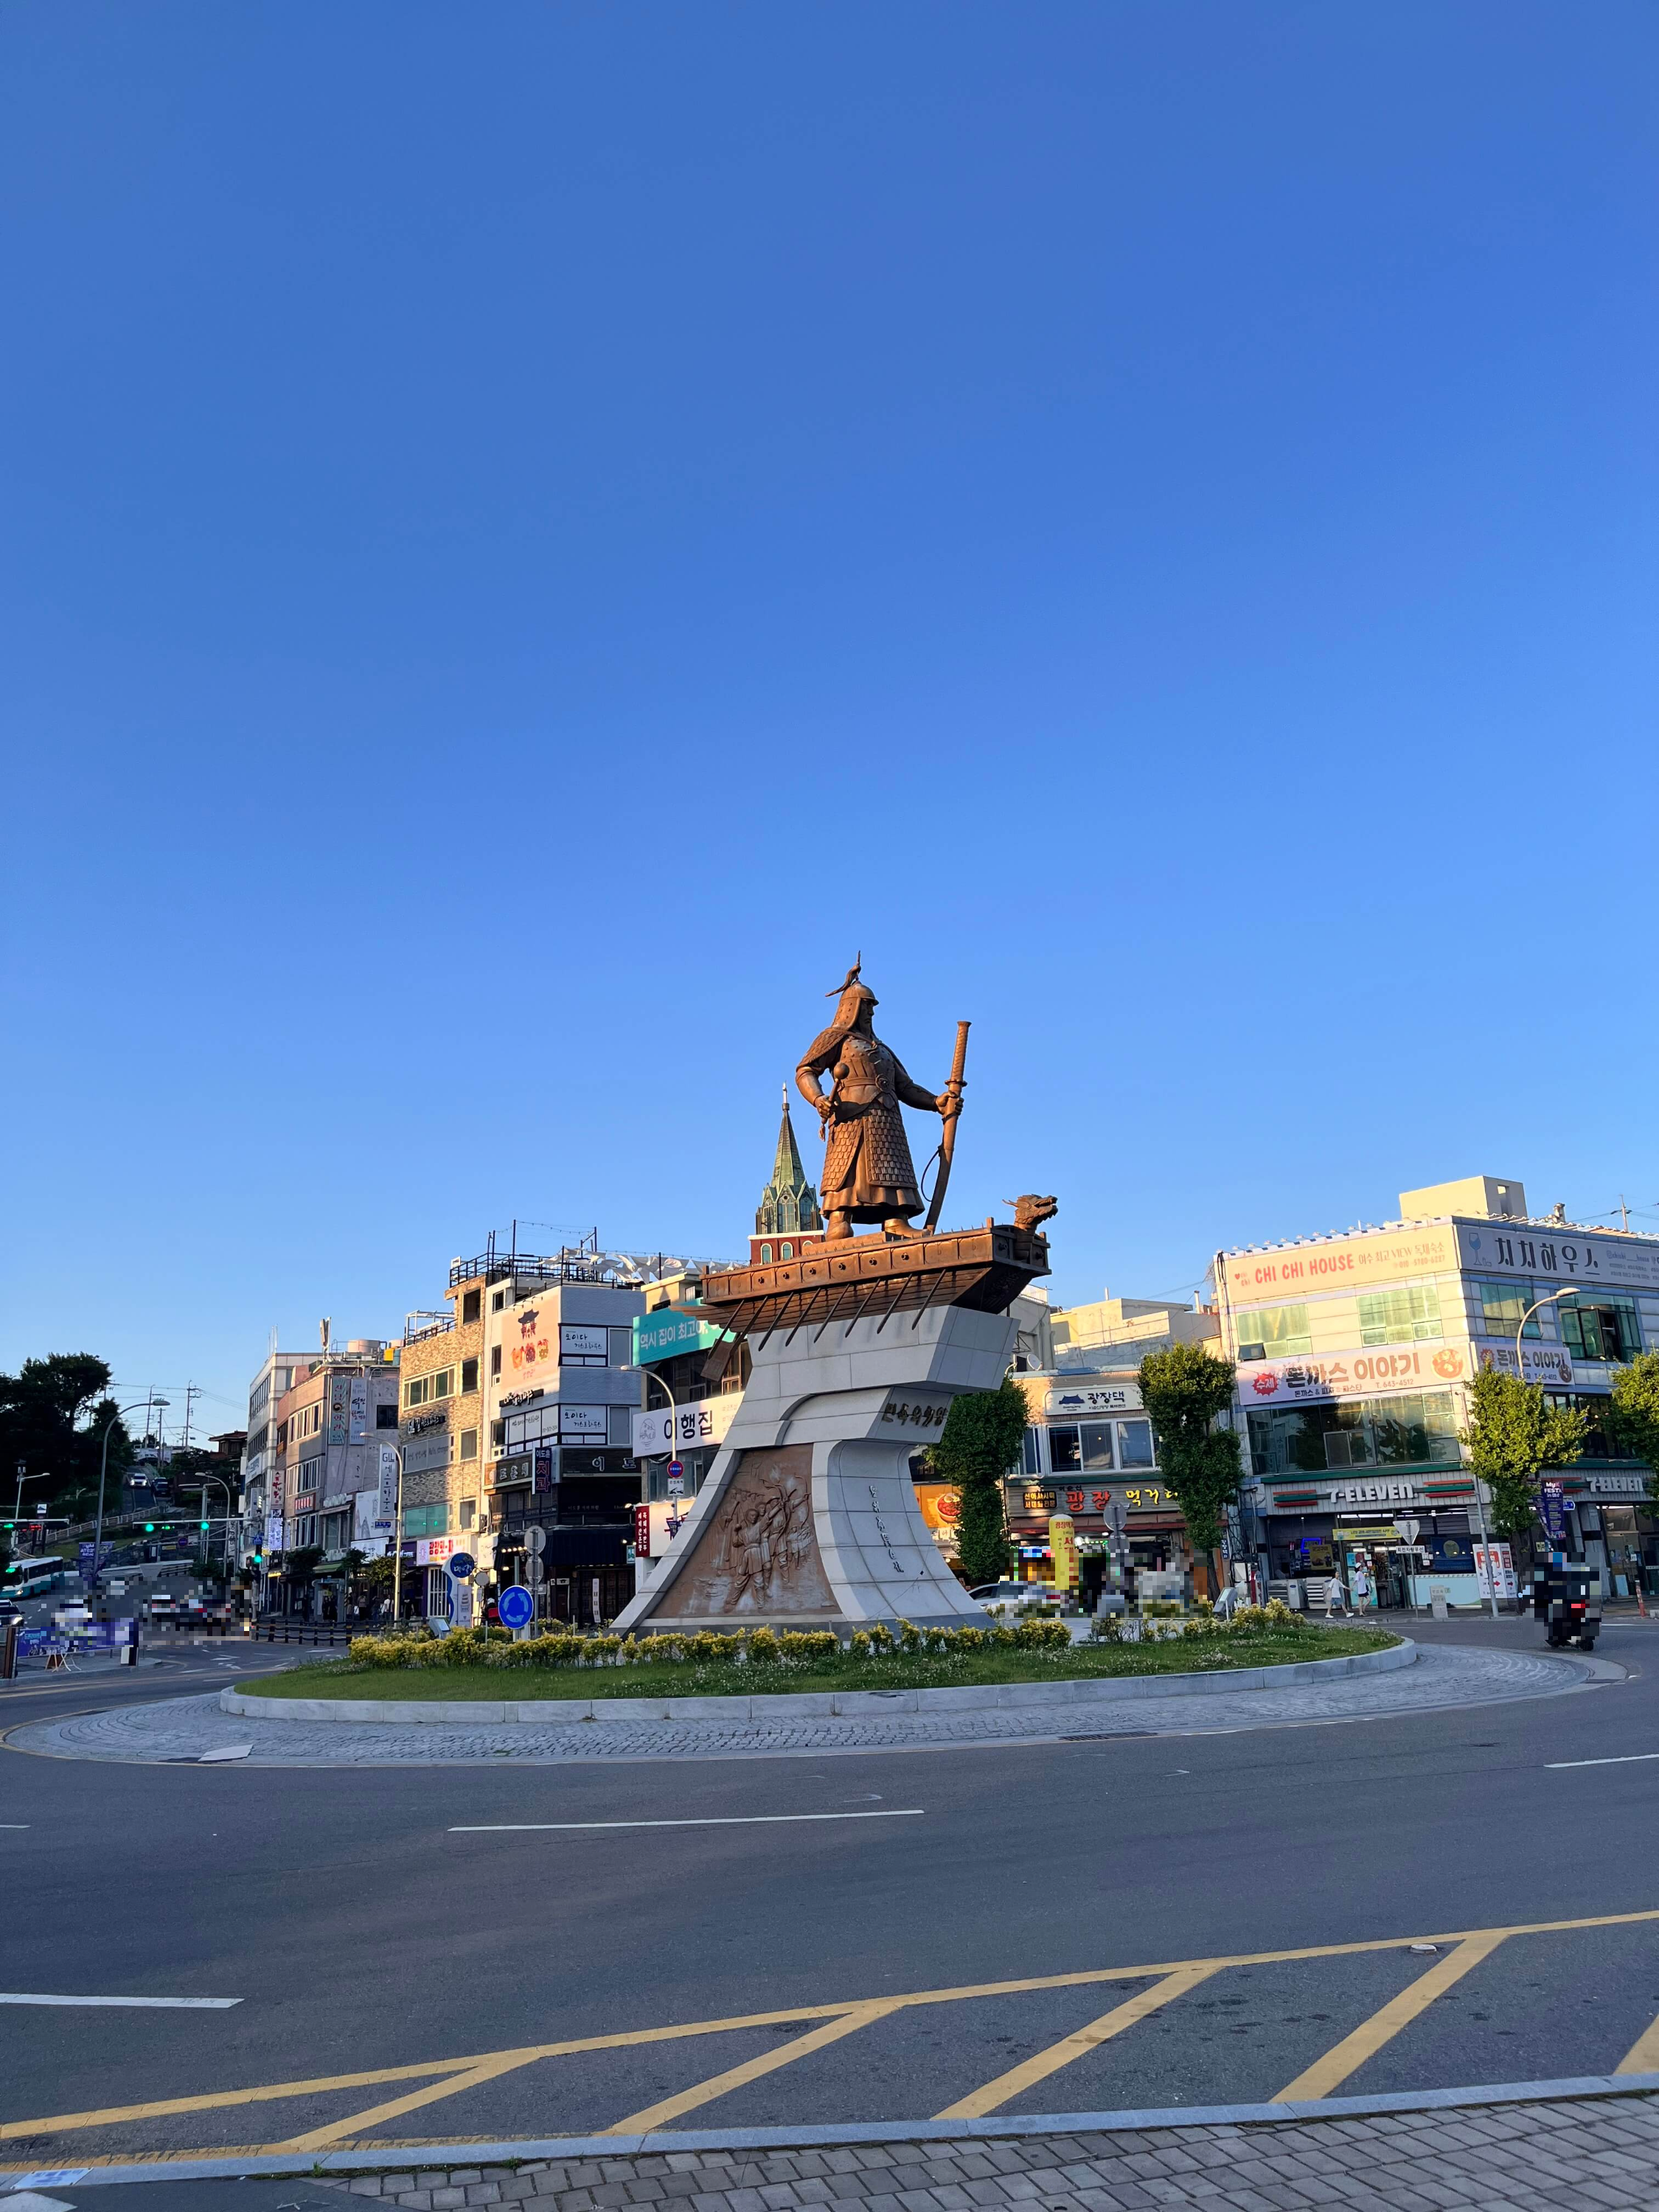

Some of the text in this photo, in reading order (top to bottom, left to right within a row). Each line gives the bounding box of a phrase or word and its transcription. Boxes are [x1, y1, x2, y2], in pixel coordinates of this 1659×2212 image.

[1495, 1237, 1601, 1276] 치치하우스
[1255, 1253, 1355, 1284] CHI CHI HOUSE
[640, 1335, 656, 1350] 역시
[658, 1326, 676, 1346] 집이
[1285, 1352, 1421, 1389] 돈까스 이야기
[1532, 1351, 1566, 1369] 이야기
[1256, 1378, 1274, 1390] 수제
[1382, 1378, 1414, 1388] 643-4512
[1087, 1391, 1125, 1405] 광장댁
[535, 1461, 551, 1492] 치과
[1065, 1489, 1110, 1511] 광장
